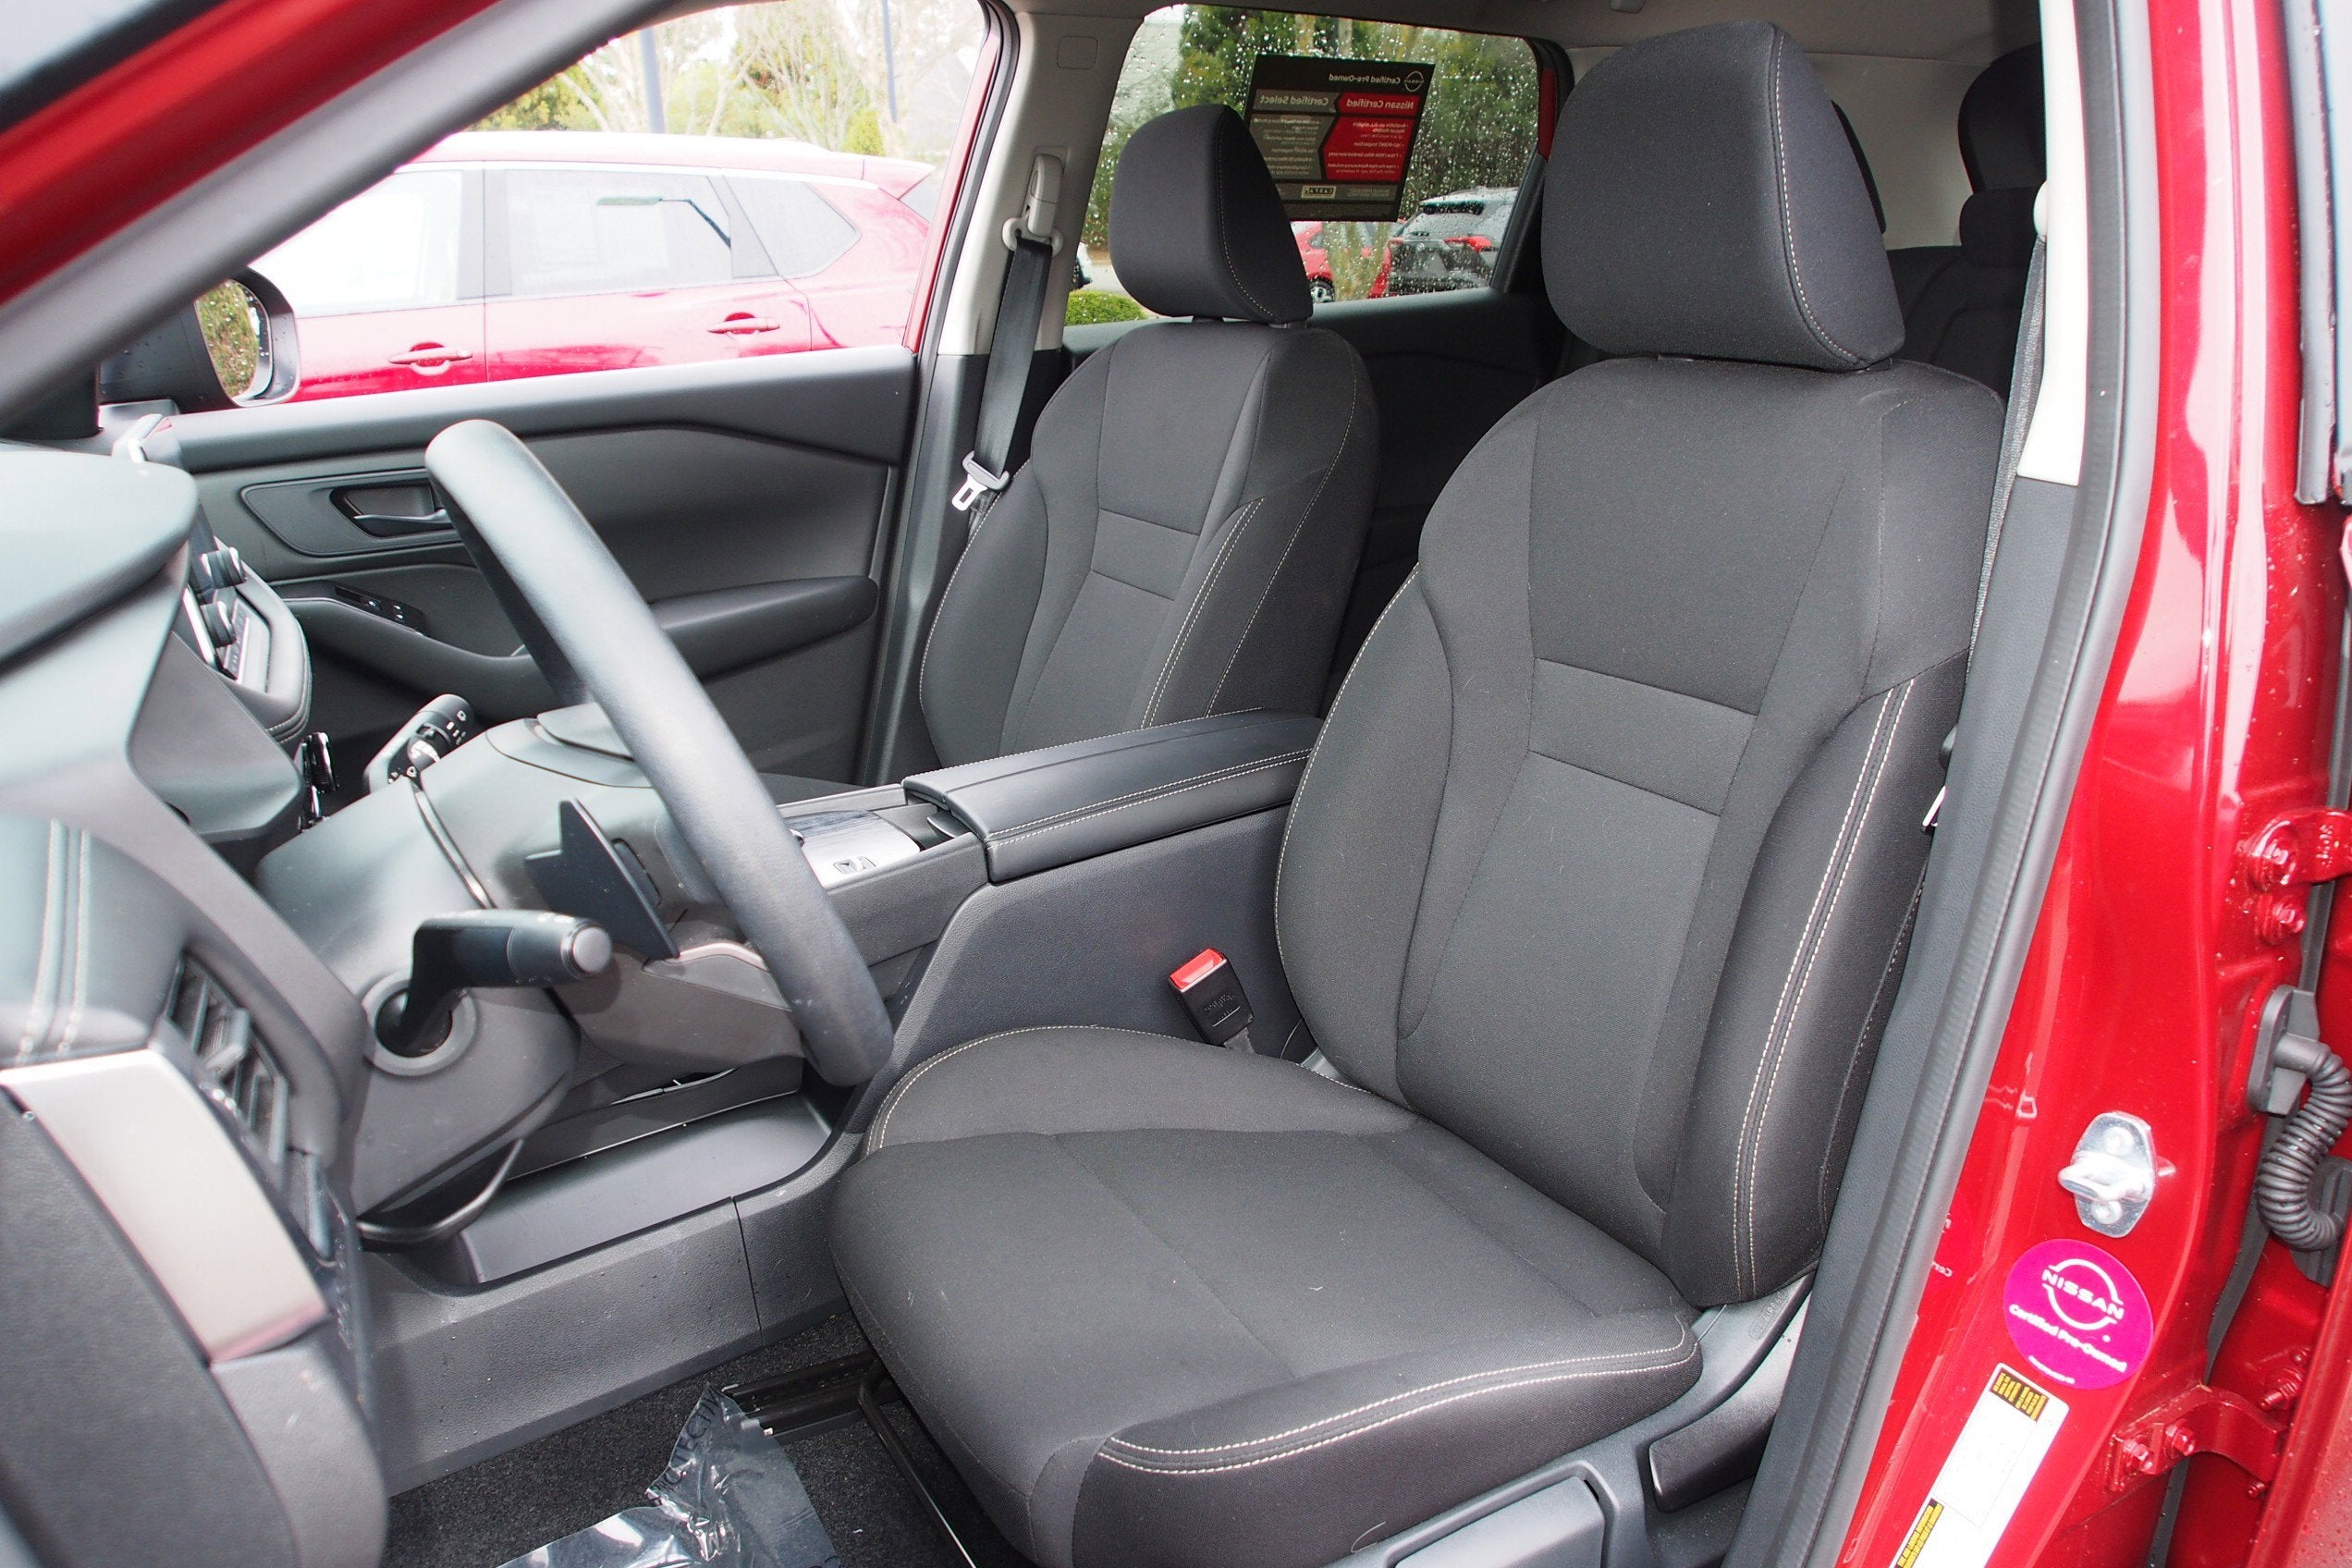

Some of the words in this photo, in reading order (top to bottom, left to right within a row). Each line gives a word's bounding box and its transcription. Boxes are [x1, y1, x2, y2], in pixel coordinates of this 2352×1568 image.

[2041, 1269, 2125, 1320] NISSAN
[2009, 1304, 2060, 1337] Certified
[2057, 1330, 2127, 1374] Pre-Owned
